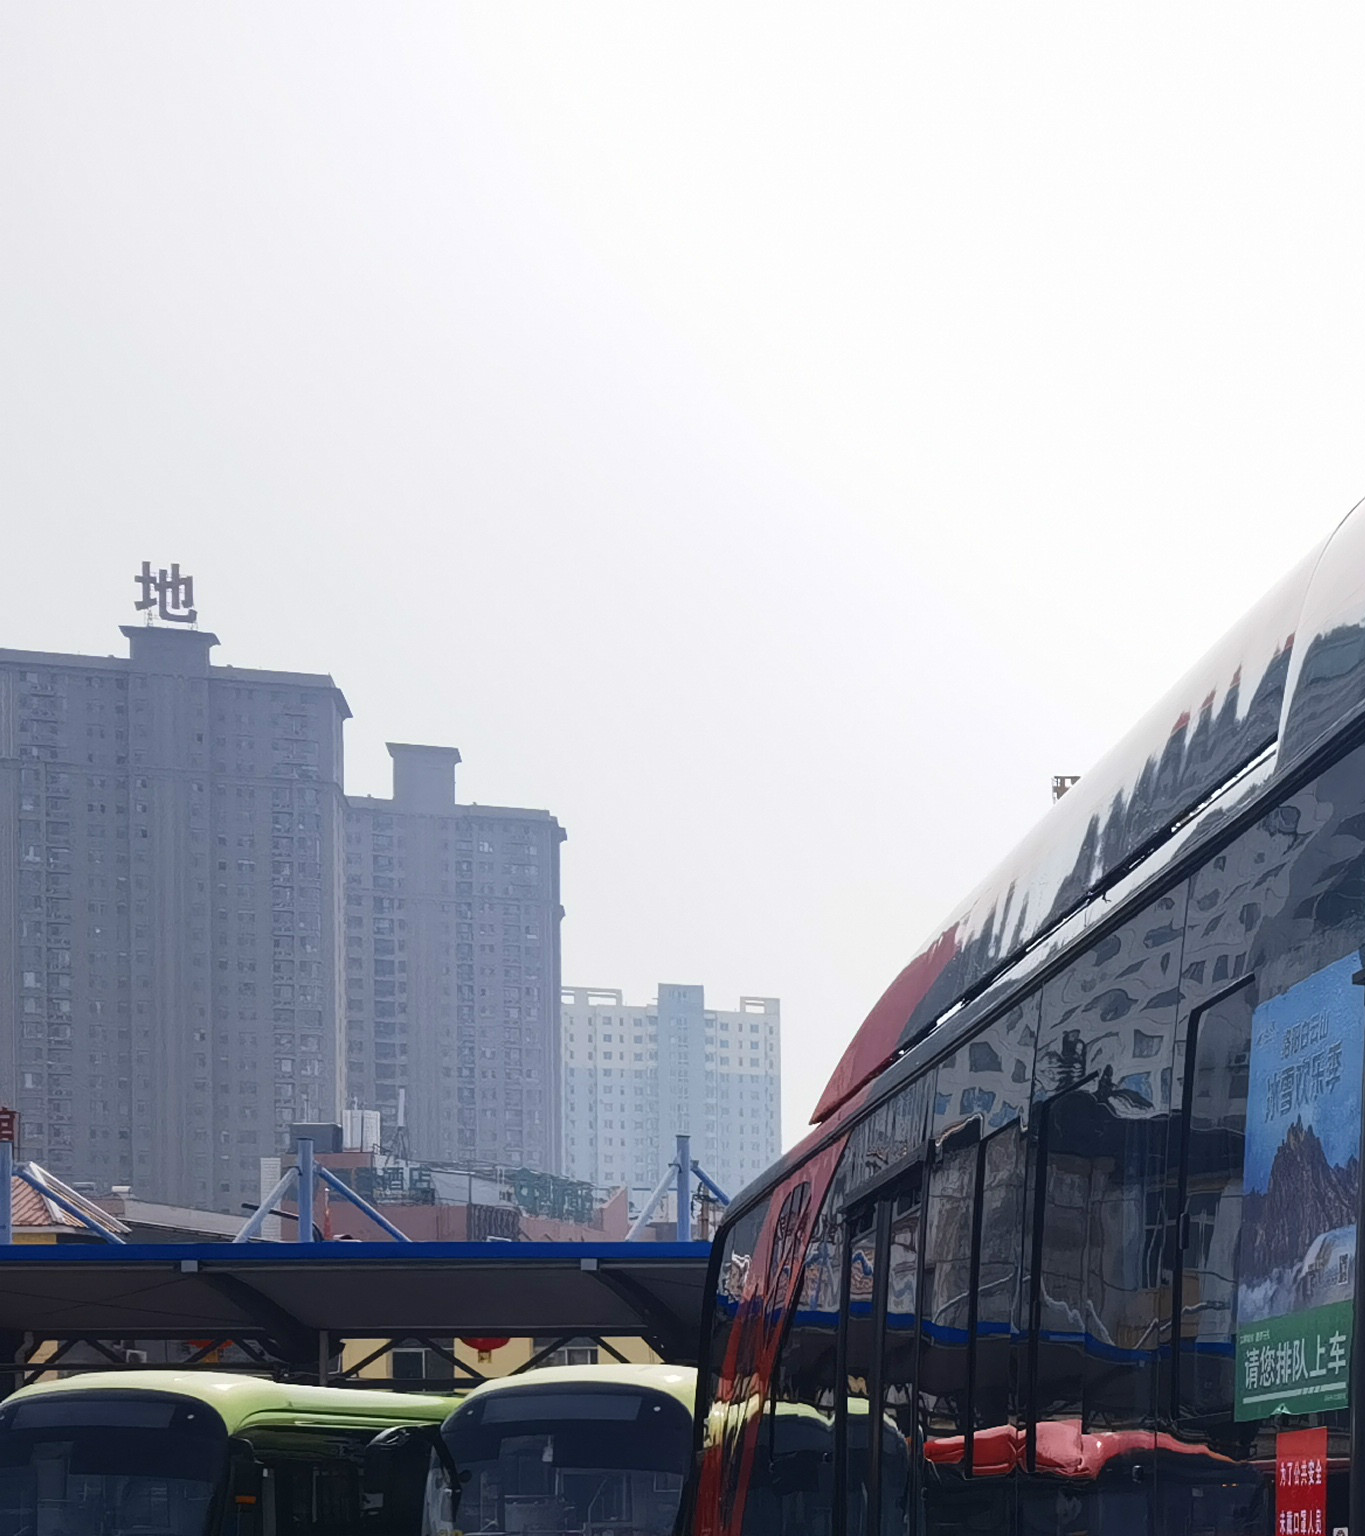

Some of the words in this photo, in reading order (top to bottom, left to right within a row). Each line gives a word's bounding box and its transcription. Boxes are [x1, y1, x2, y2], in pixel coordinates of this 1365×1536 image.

[134, 561, 198, 622] 地
[1265, 1040, 1343, 1123] 冰雪欢乐季
[1245, 1331, 1347, 1390] 请您排队上车
[1279, 1459, 1322, 1486] 为了公共安全
[1279, 1509, 1322, 1536] 未戴口罩人员
